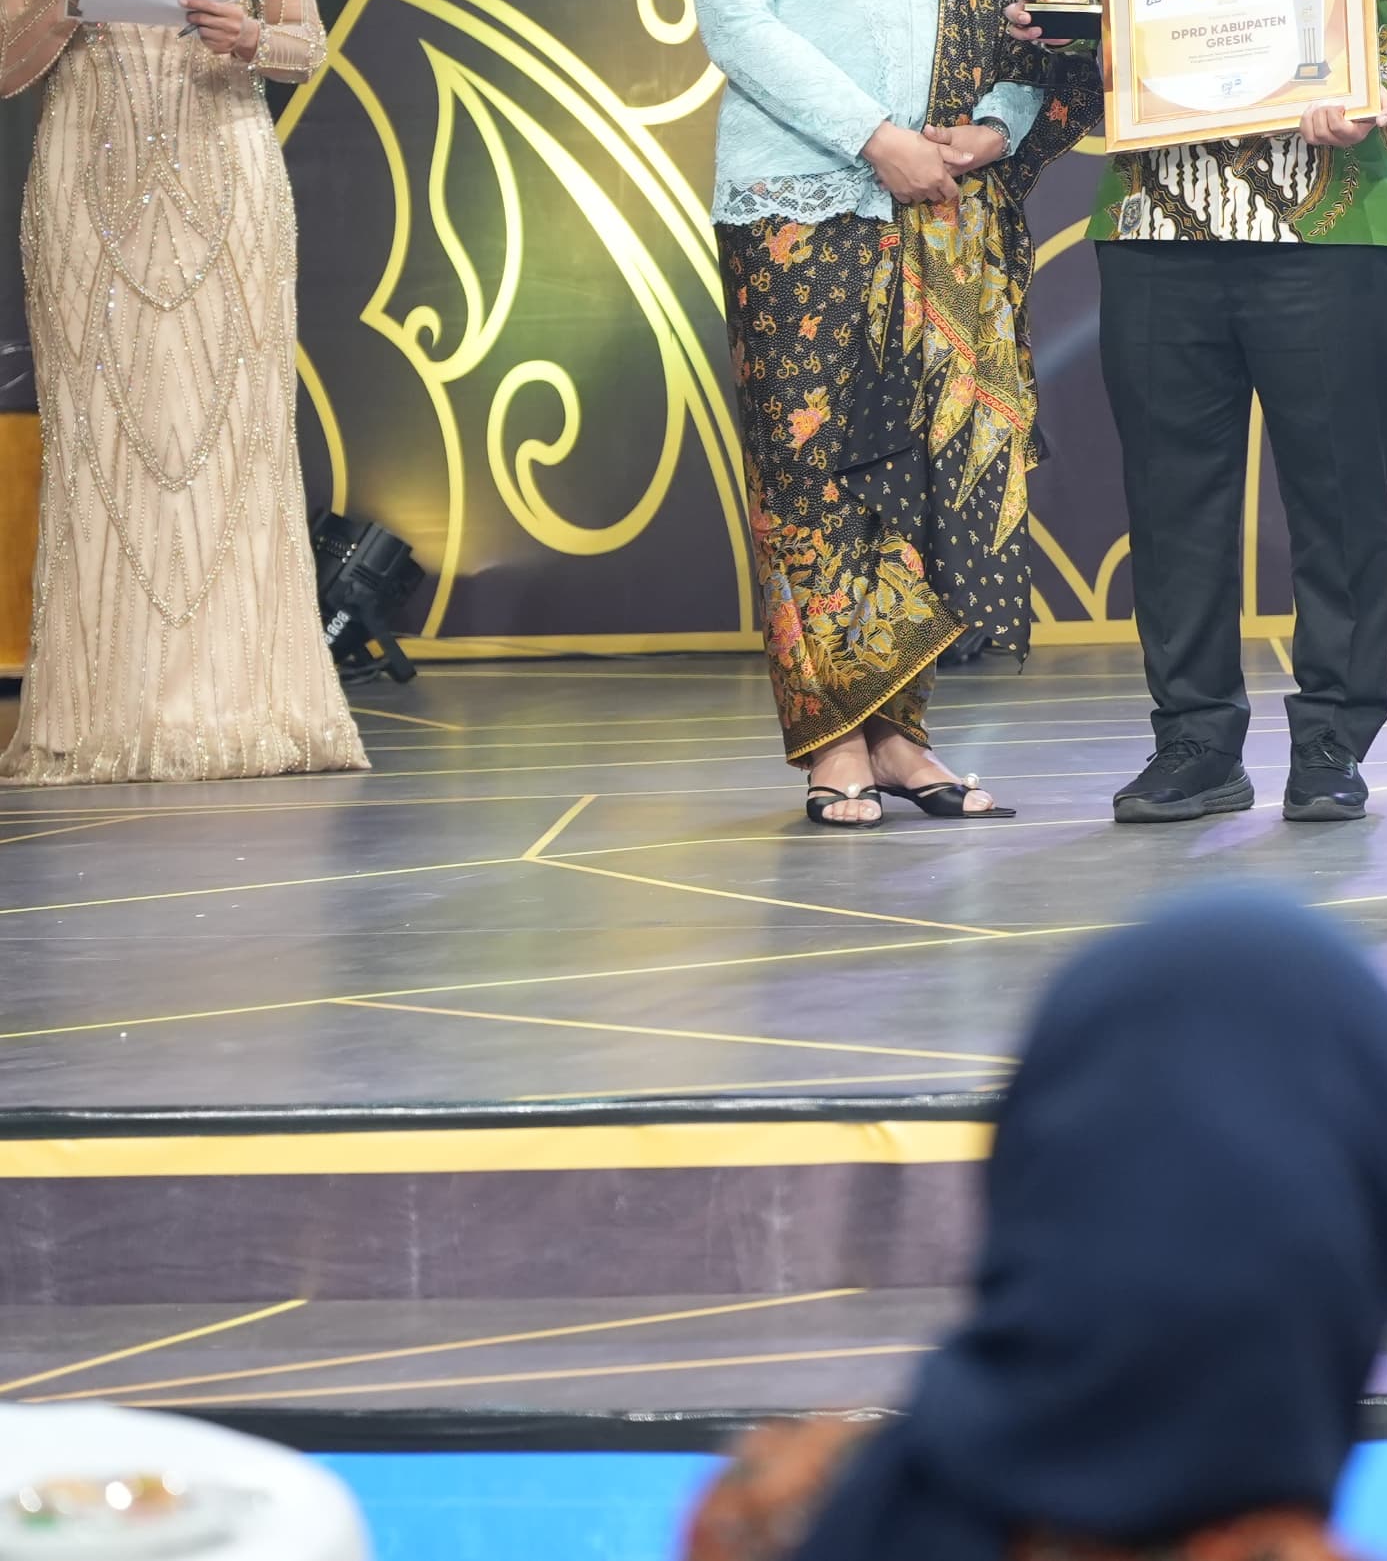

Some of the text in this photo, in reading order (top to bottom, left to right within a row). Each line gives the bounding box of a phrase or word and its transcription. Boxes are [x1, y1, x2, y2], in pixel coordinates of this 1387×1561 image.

[1171, 26, 1207, 40] DPRD
[1211, 15, 1286, 35] KABUPATEN
[1206, 33, 1253, 48] GRESIK
